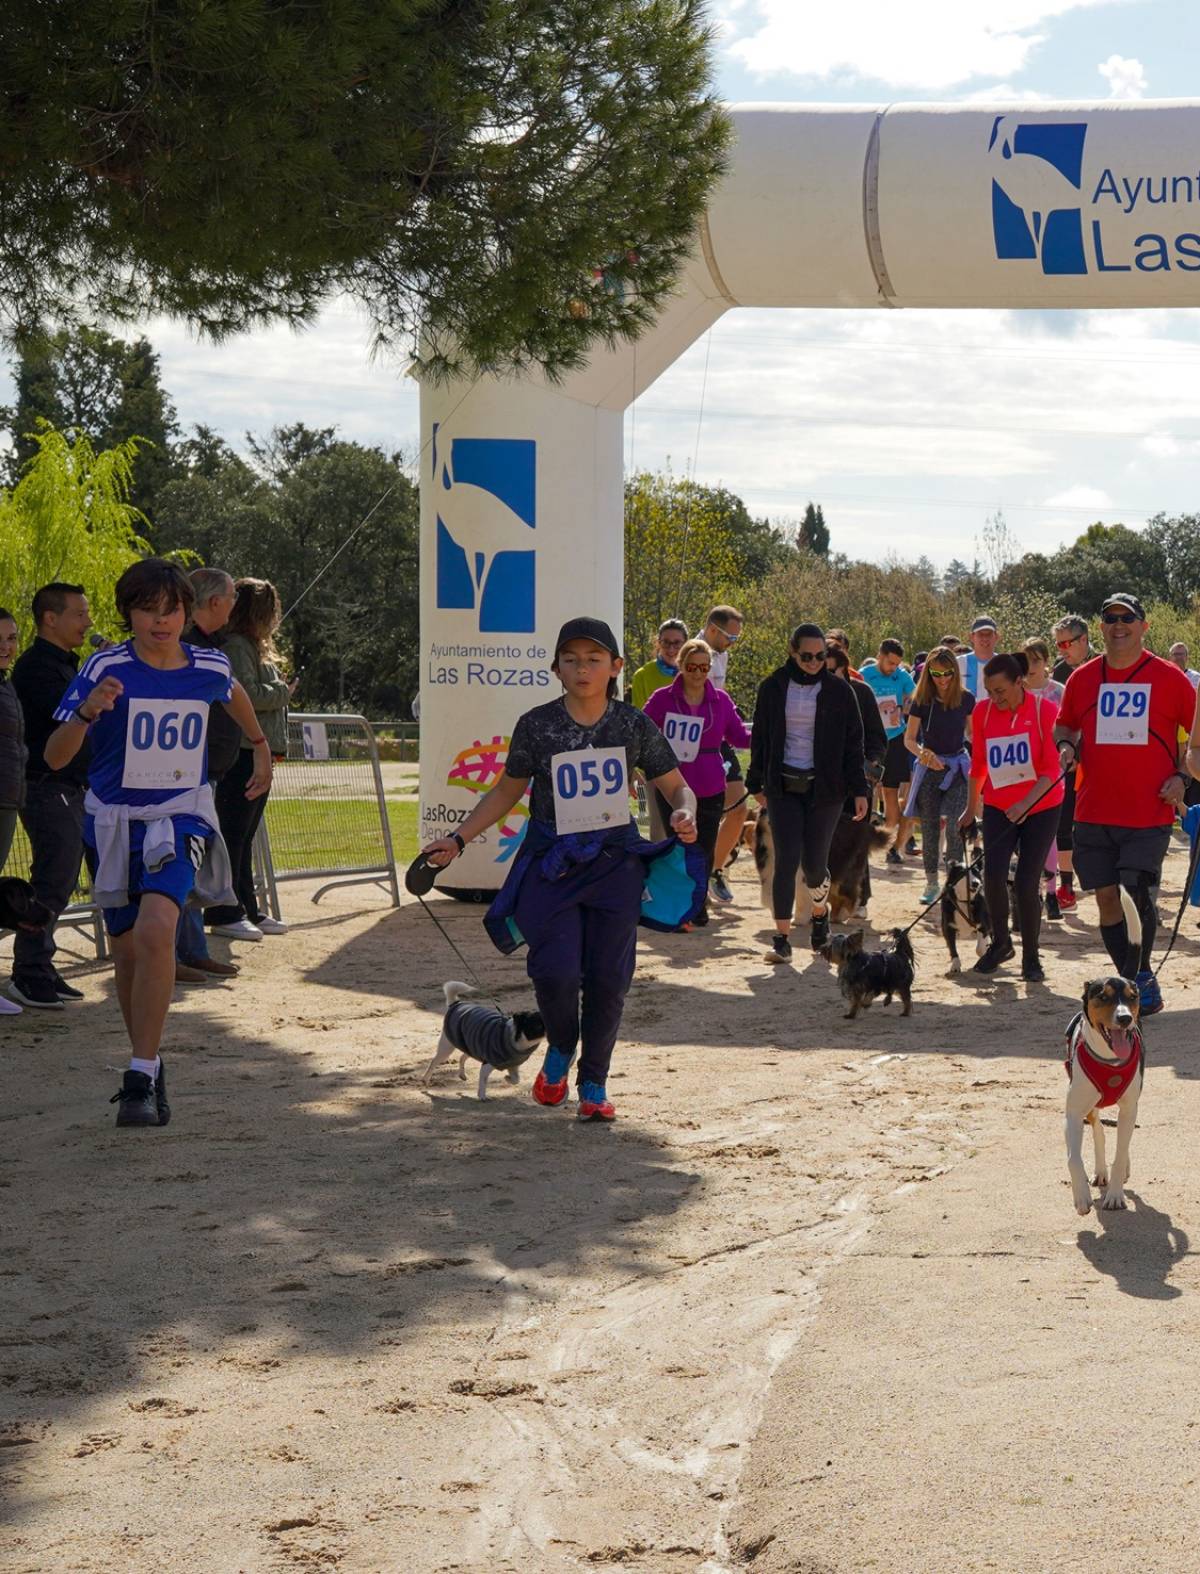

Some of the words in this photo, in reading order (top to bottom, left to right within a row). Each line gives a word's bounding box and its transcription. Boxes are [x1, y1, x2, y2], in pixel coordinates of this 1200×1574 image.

[430, 642, 522, 660] Ayuntamiento
[526, 645, 548, 659] de
[429, 661, 459, 685] Las
[466, 662, 550, 687] Rozas
[1100, 690, 1147, 718] 029
[132, 711, 203, 751] 060
[666, 719, 701, 743] 010
[989, 740, 1029, 769] 040
[556, 758, 624, 800] 059
[422, 799, 474, 823] LasRoz
